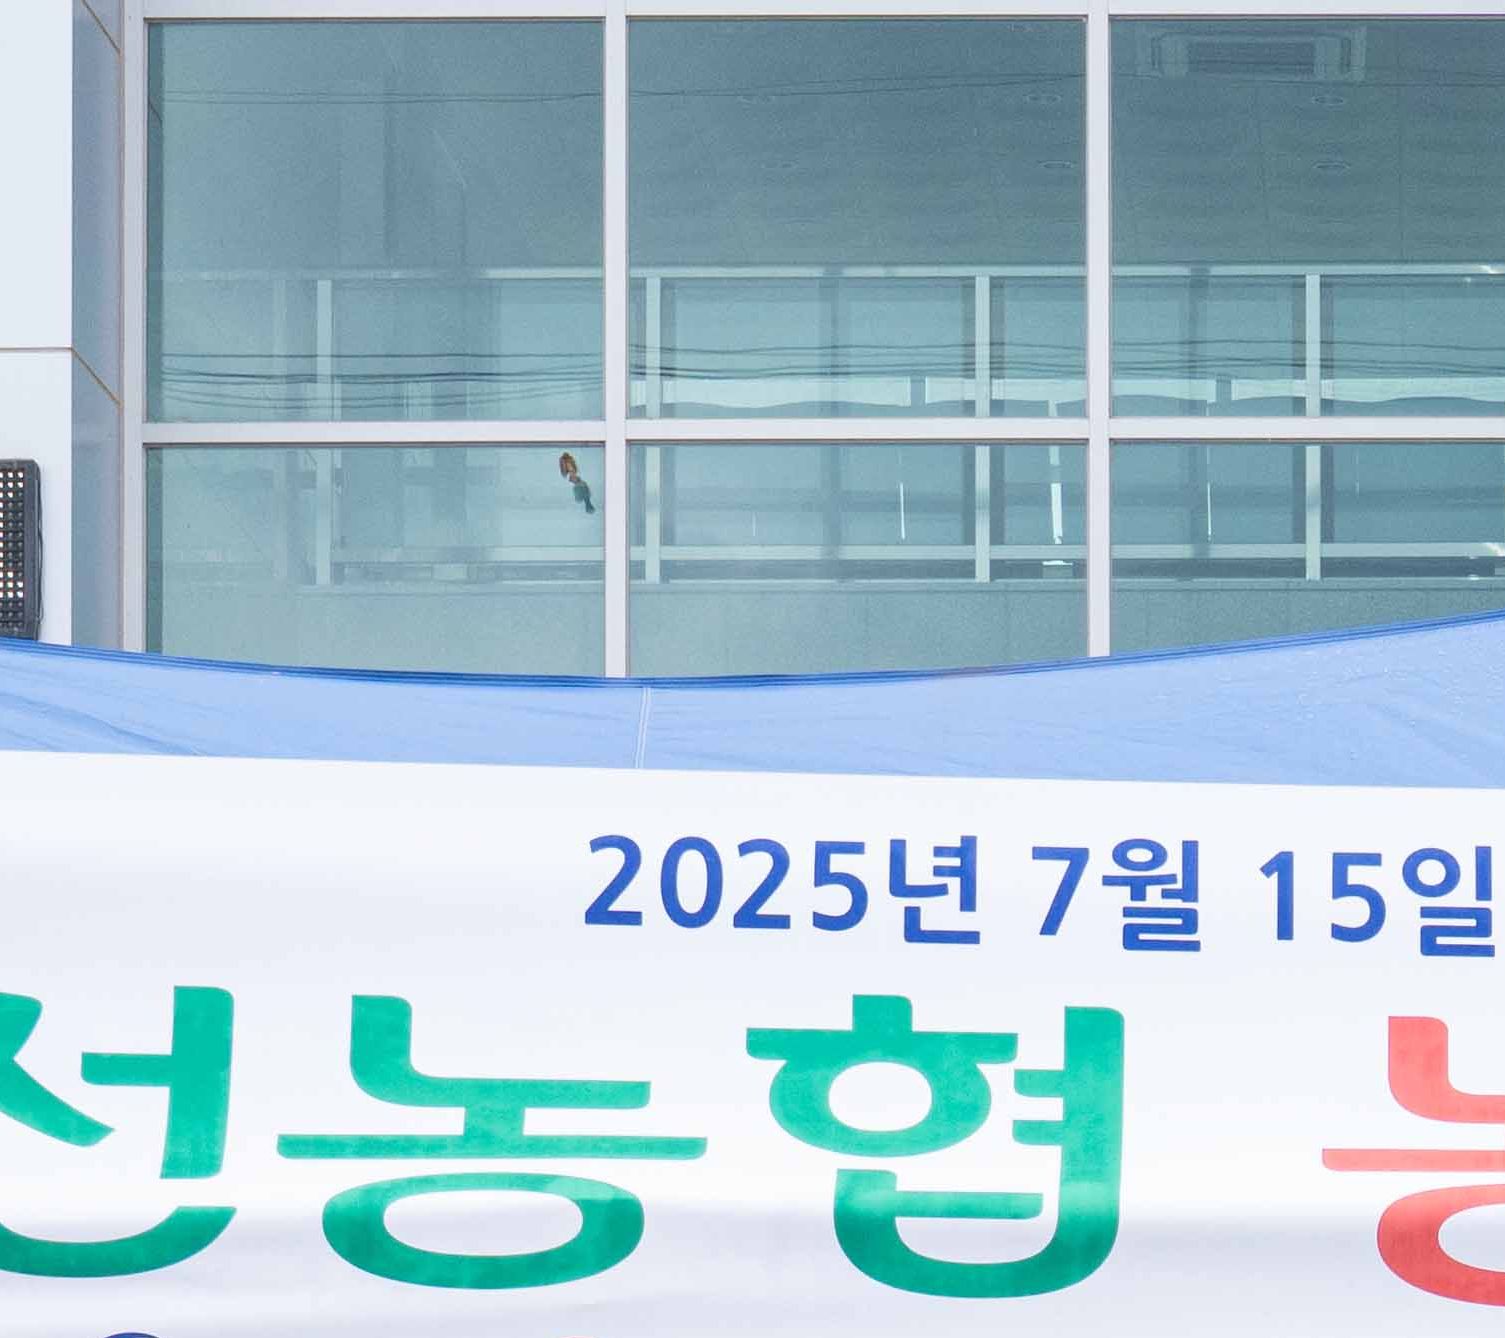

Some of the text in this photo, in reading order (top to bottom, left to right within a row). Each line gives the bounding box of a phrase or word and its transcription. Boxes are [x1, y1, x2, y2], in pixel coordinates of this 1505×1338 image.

[585, 836, 980, 944] 2025년
[1032, 839, 1200, 952] 7월
[1262, 847, 1494, 957] 15일
